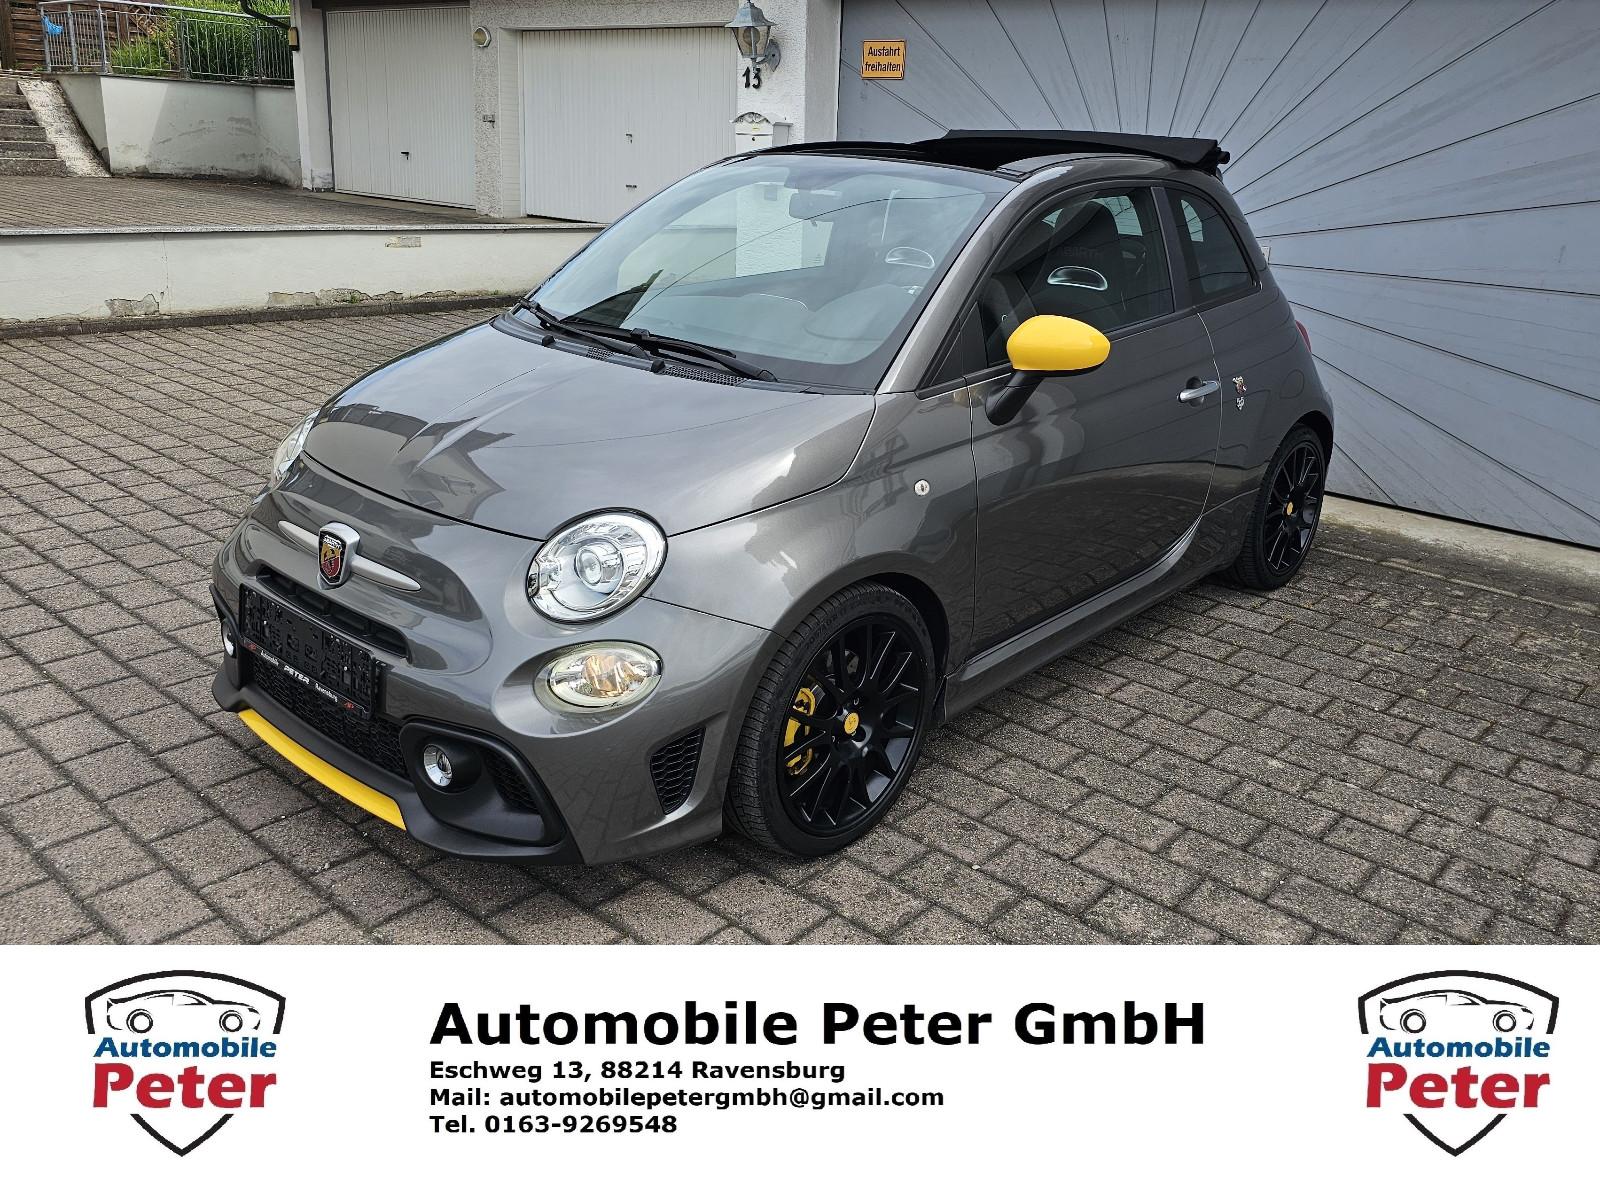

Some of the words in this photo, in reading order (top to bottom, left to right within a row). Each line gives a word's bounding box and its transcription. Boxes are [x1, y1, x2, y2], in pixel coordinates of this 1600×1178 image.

[867, 46, 901, 57] Ausfahrt
[864, 61, 901, 72] freihalten
[742, 67, 762, 89] 13
[284, 665, 310, 685] PETER
